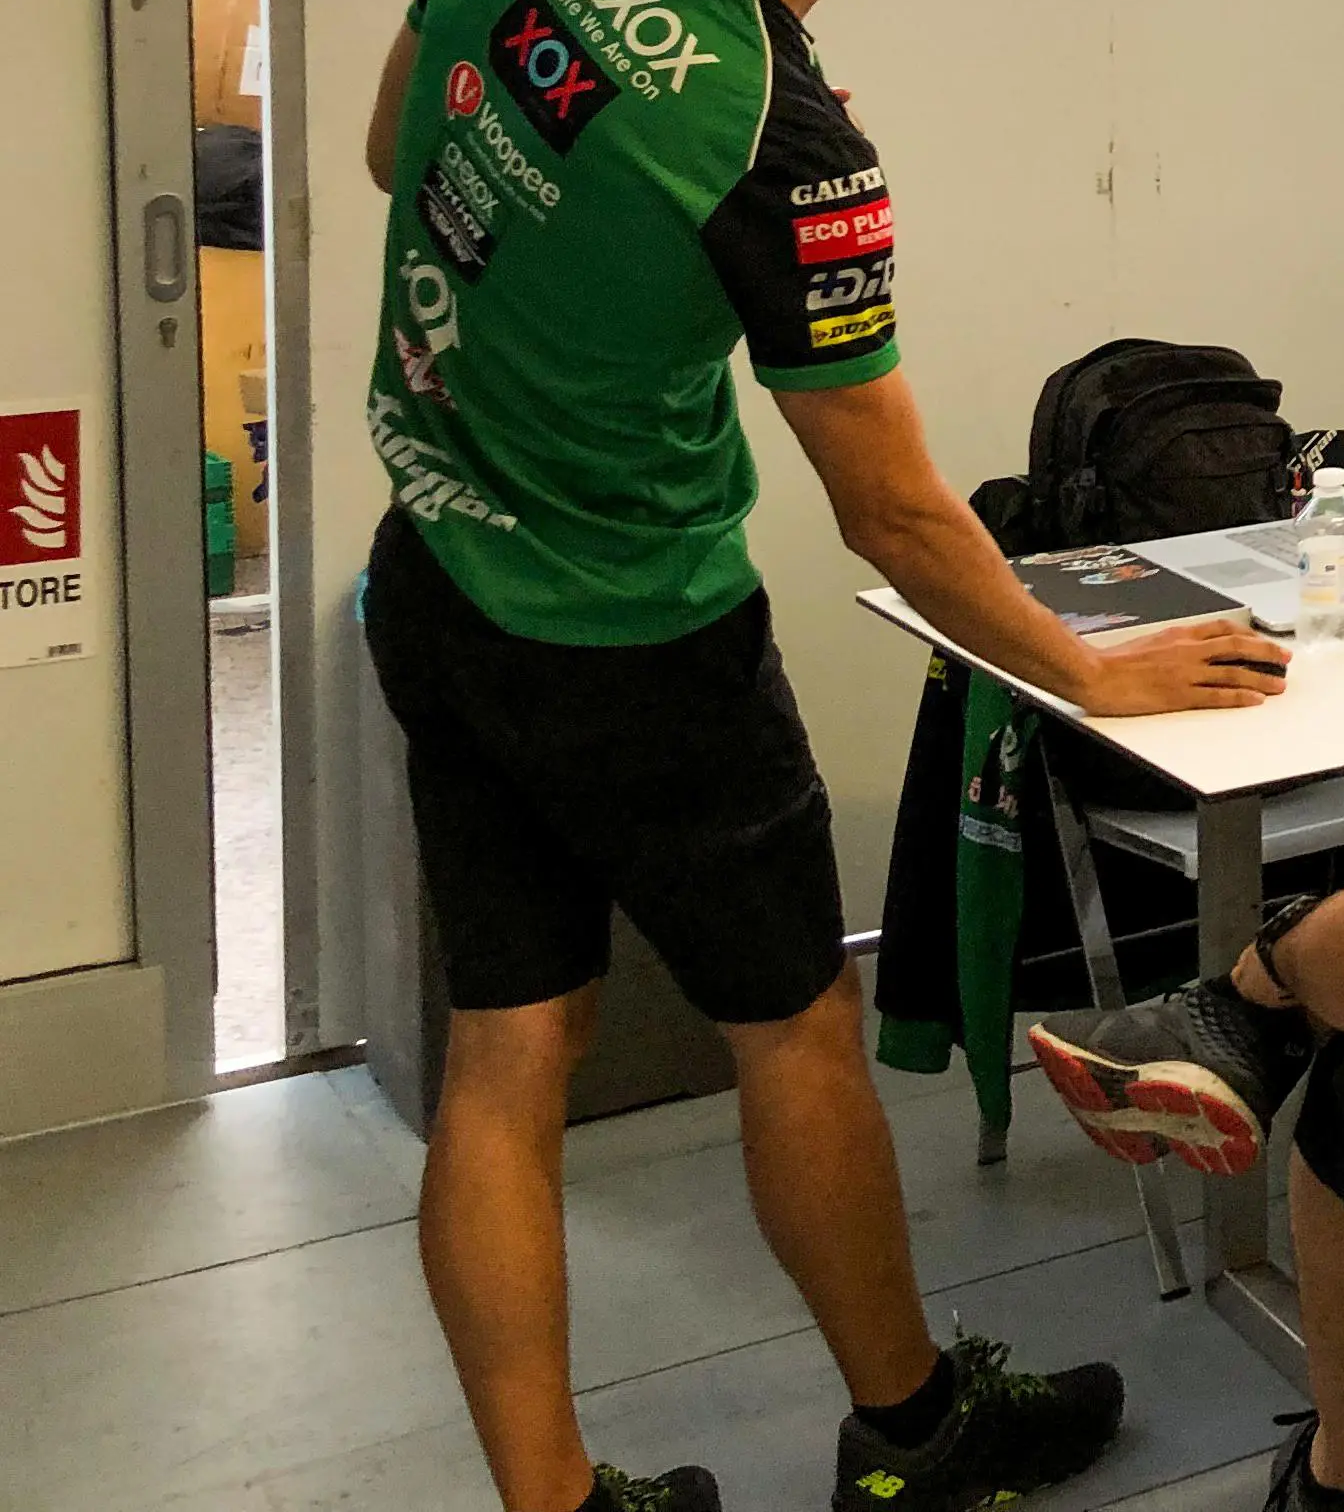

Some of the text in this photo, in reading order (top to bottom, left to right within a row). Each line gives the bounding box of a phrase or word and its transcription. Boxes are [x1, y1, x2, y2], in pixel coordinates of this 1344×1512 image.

[505, 8, 596, 120] XOX
[580, 11, 605, 42] We
[600, 41, 631, 72] Are
[631, 70, 661, 101] On
[478, 102, 561, 207] Voopee
[799, 219, 850, 244] ECO
[0, 573, 82, 610] TORE
